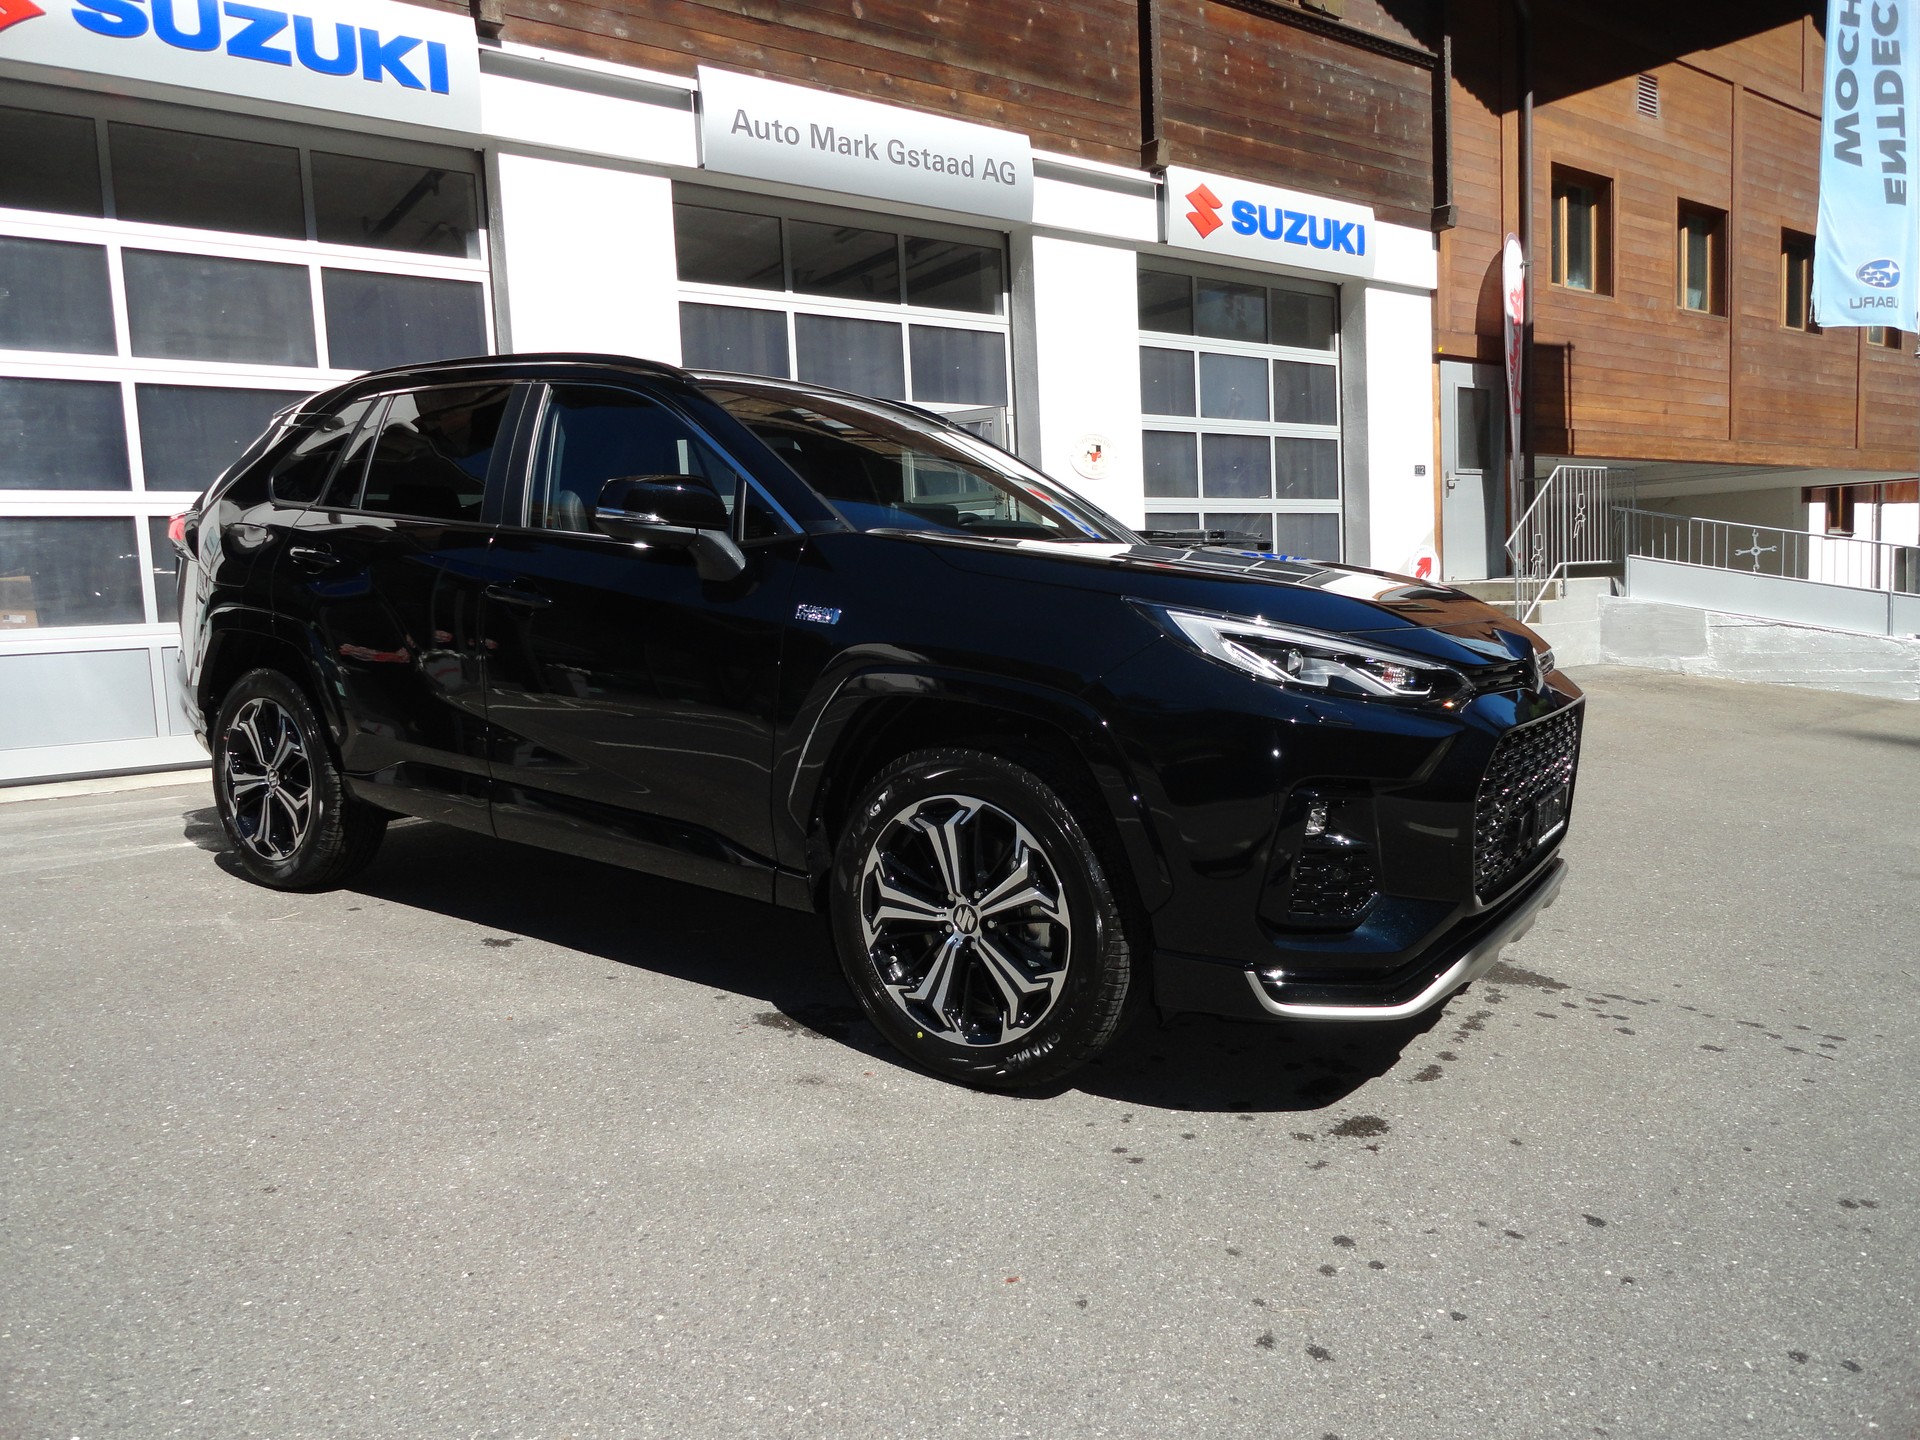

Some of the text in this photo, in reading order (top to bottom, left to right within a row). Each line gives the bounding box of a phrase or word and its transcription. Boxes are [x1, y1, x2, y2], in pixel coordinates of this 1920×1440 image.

[71, 0, 450, 95] SUZUKI
[731, 109, 1016, 186] Auto Mark Gstaad AG
[1231, 200, 1366, 256] SUZUKI
